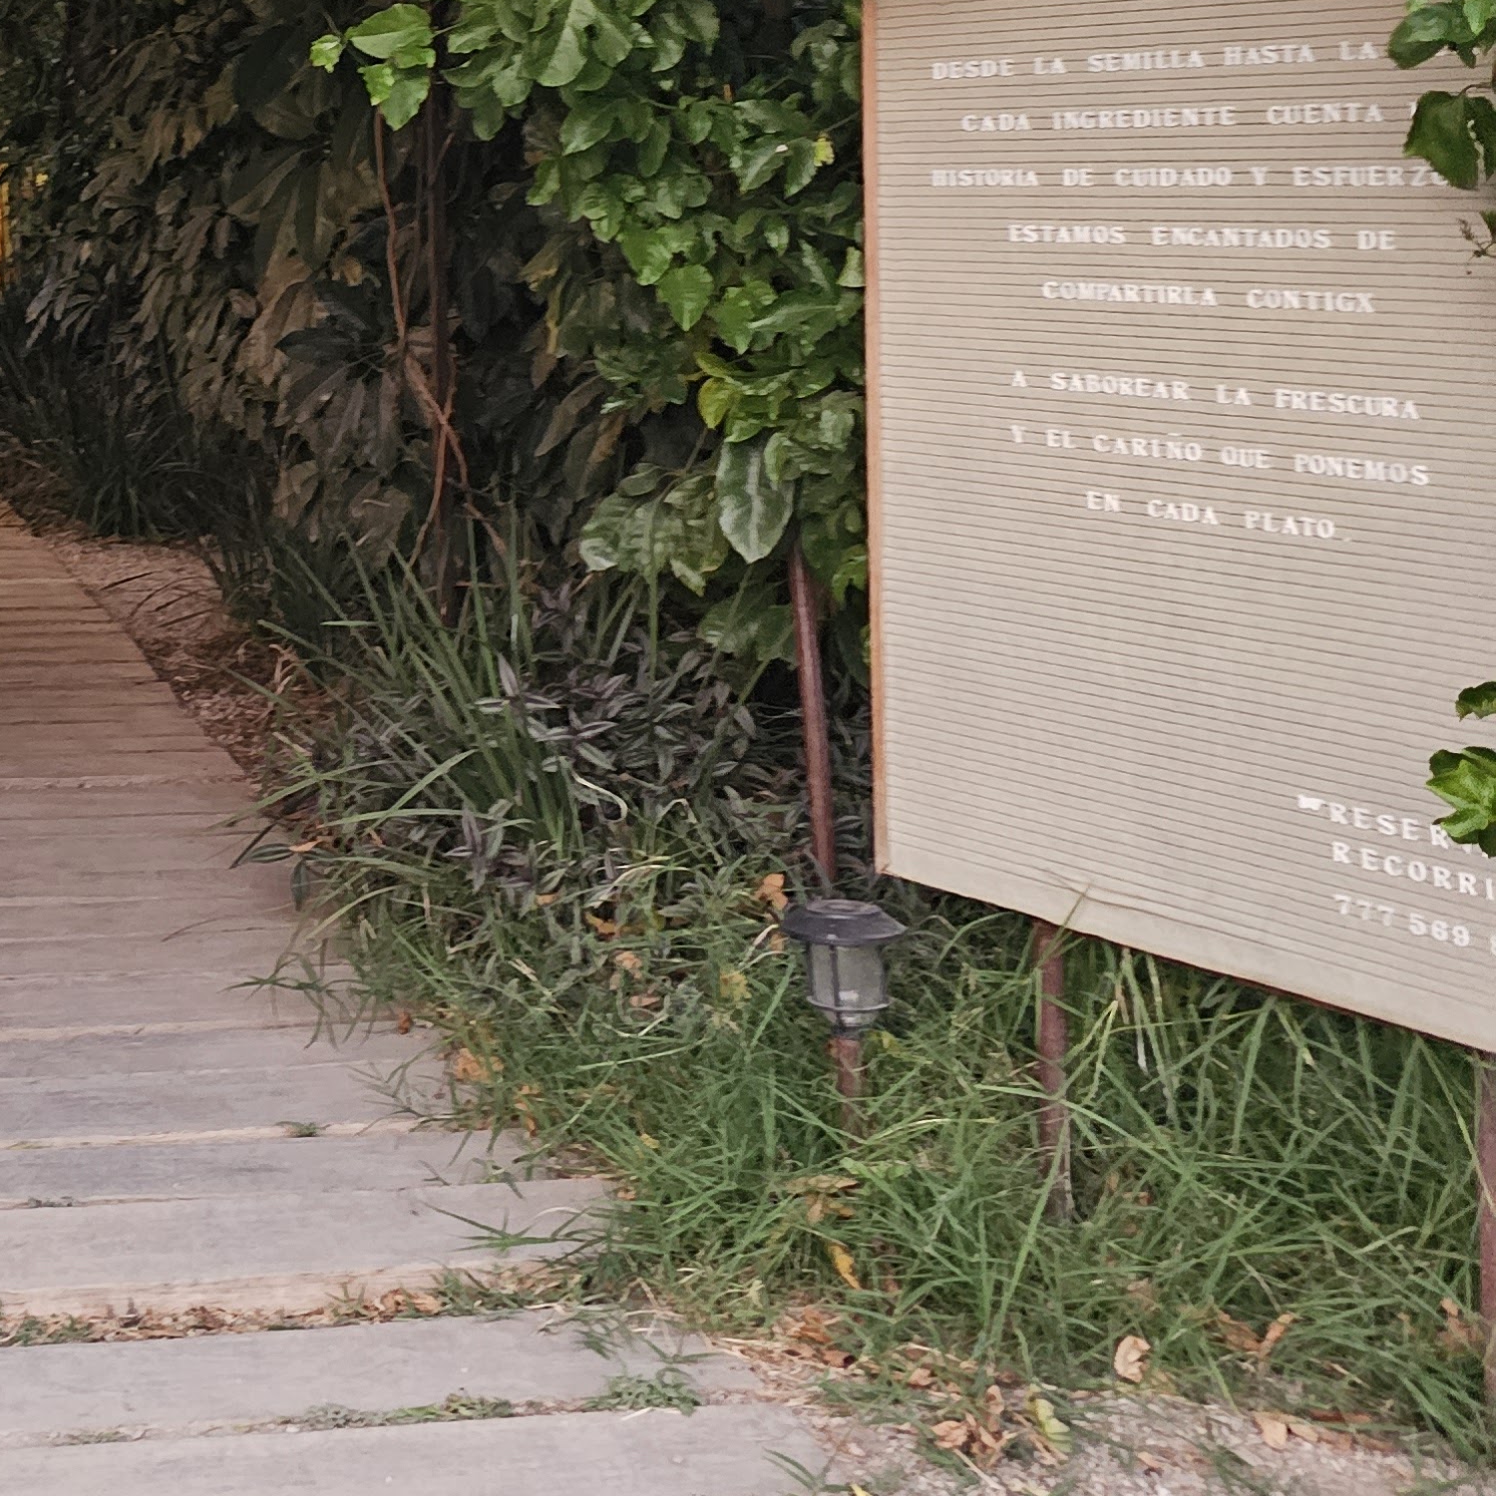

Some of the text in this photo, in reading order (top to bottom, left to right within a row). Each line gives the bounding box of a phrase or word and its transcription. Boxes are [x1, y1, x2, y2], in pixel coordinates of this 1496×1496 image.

[932, 41, 1379, 80] DESDE LA SEMILLA HASTA LA
[960, 113, 1031, 132] CADA
[1053, 106, 1237, 129] INGREDIENTE
[1266, 102, 1384, 125] CUENTA
[931, 169, 1039, 187] HISTORIA
[1062, 168, 1095, 186] DE
[1114, 166, 1233, 187] CUIDADO
[1250, 166, 1268, 186] Y
[1007, 223, 1397, 250] ESTAMOS ENCANTADOS DE
[1041, 281, 1375, 313] COMPARTIRLA CONTIGX
[1012, 370, 1420, 420] A SABOREAR LA FRESCURA
[1011, 425, 1430, 486] Y EL CARIÑO QUE PONEMOS
[1085, 491, 1121, 513] EN
[1147, 499, 1219, 525] CADA
[1333, 894, 1395, 927] 777
